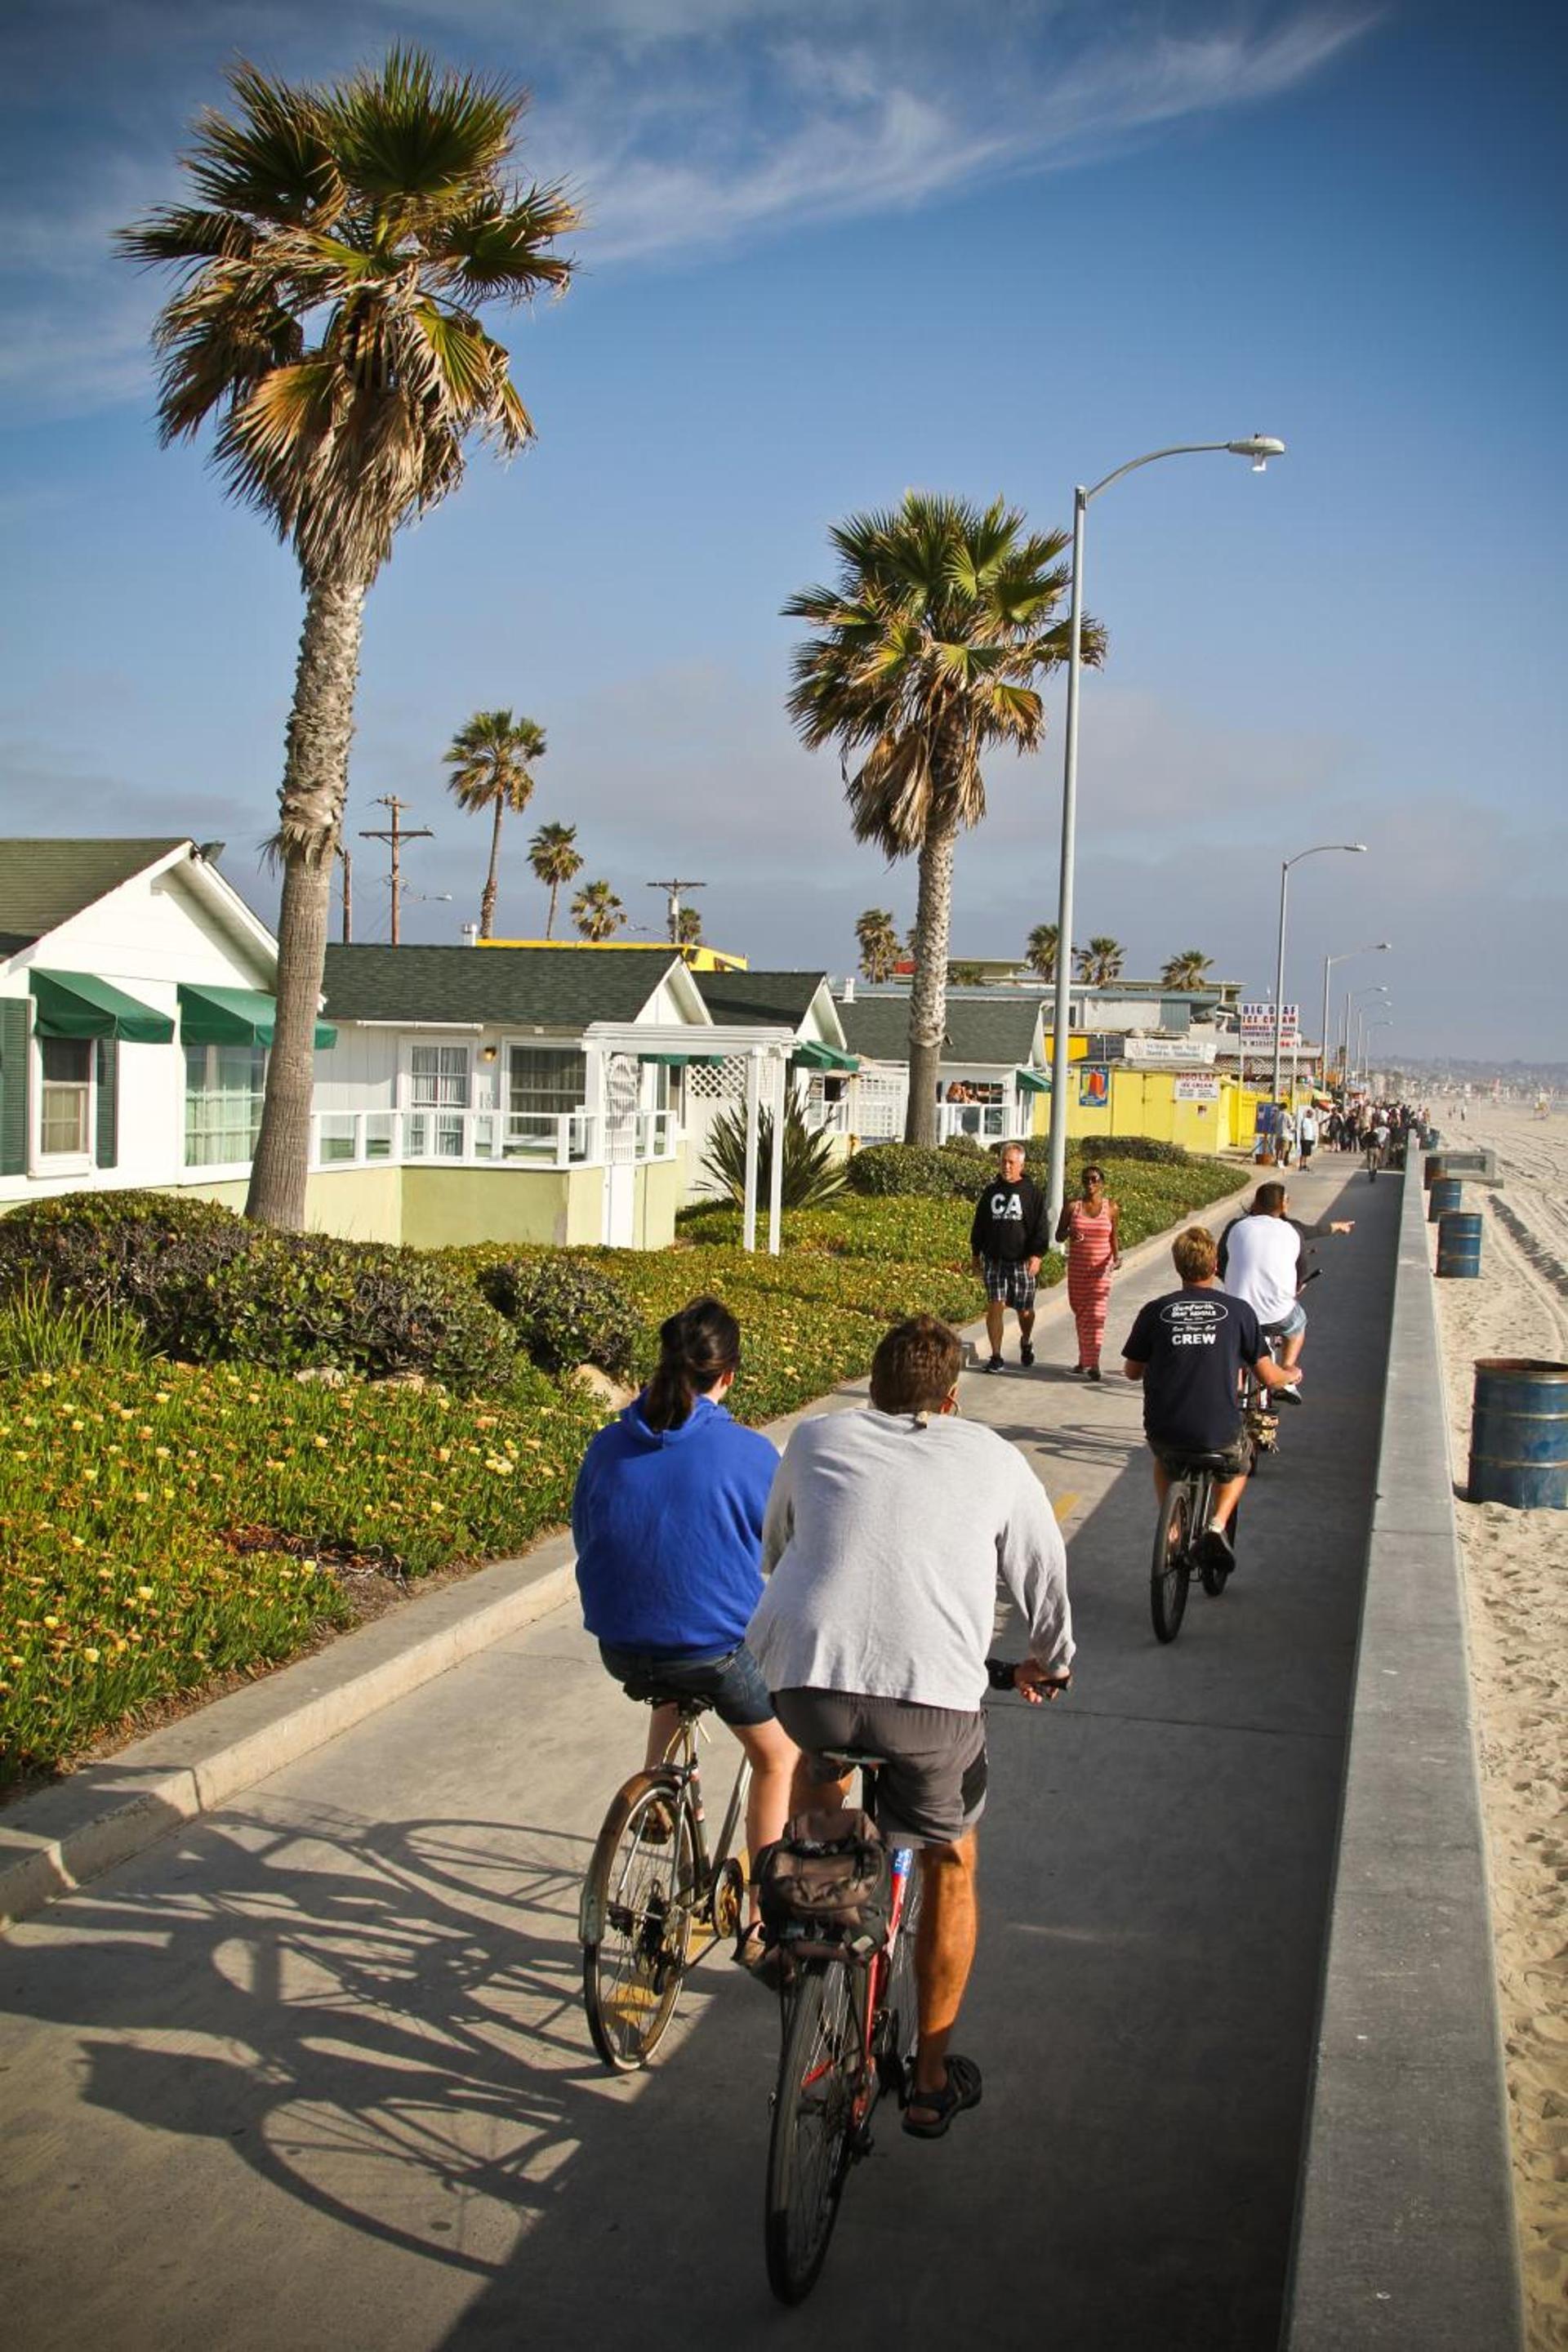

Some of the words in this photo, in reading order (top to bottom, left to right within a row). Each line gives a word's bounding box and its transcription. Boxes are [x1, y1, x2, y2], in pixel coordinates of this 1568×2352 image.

[1243, 1005, 1263, 1014] BIG
[1268, 1005, 1295, 1015] OAF
[991, 1193, 1022, 1214] CA
[1172, 1334, 1216, 1345] CREW
